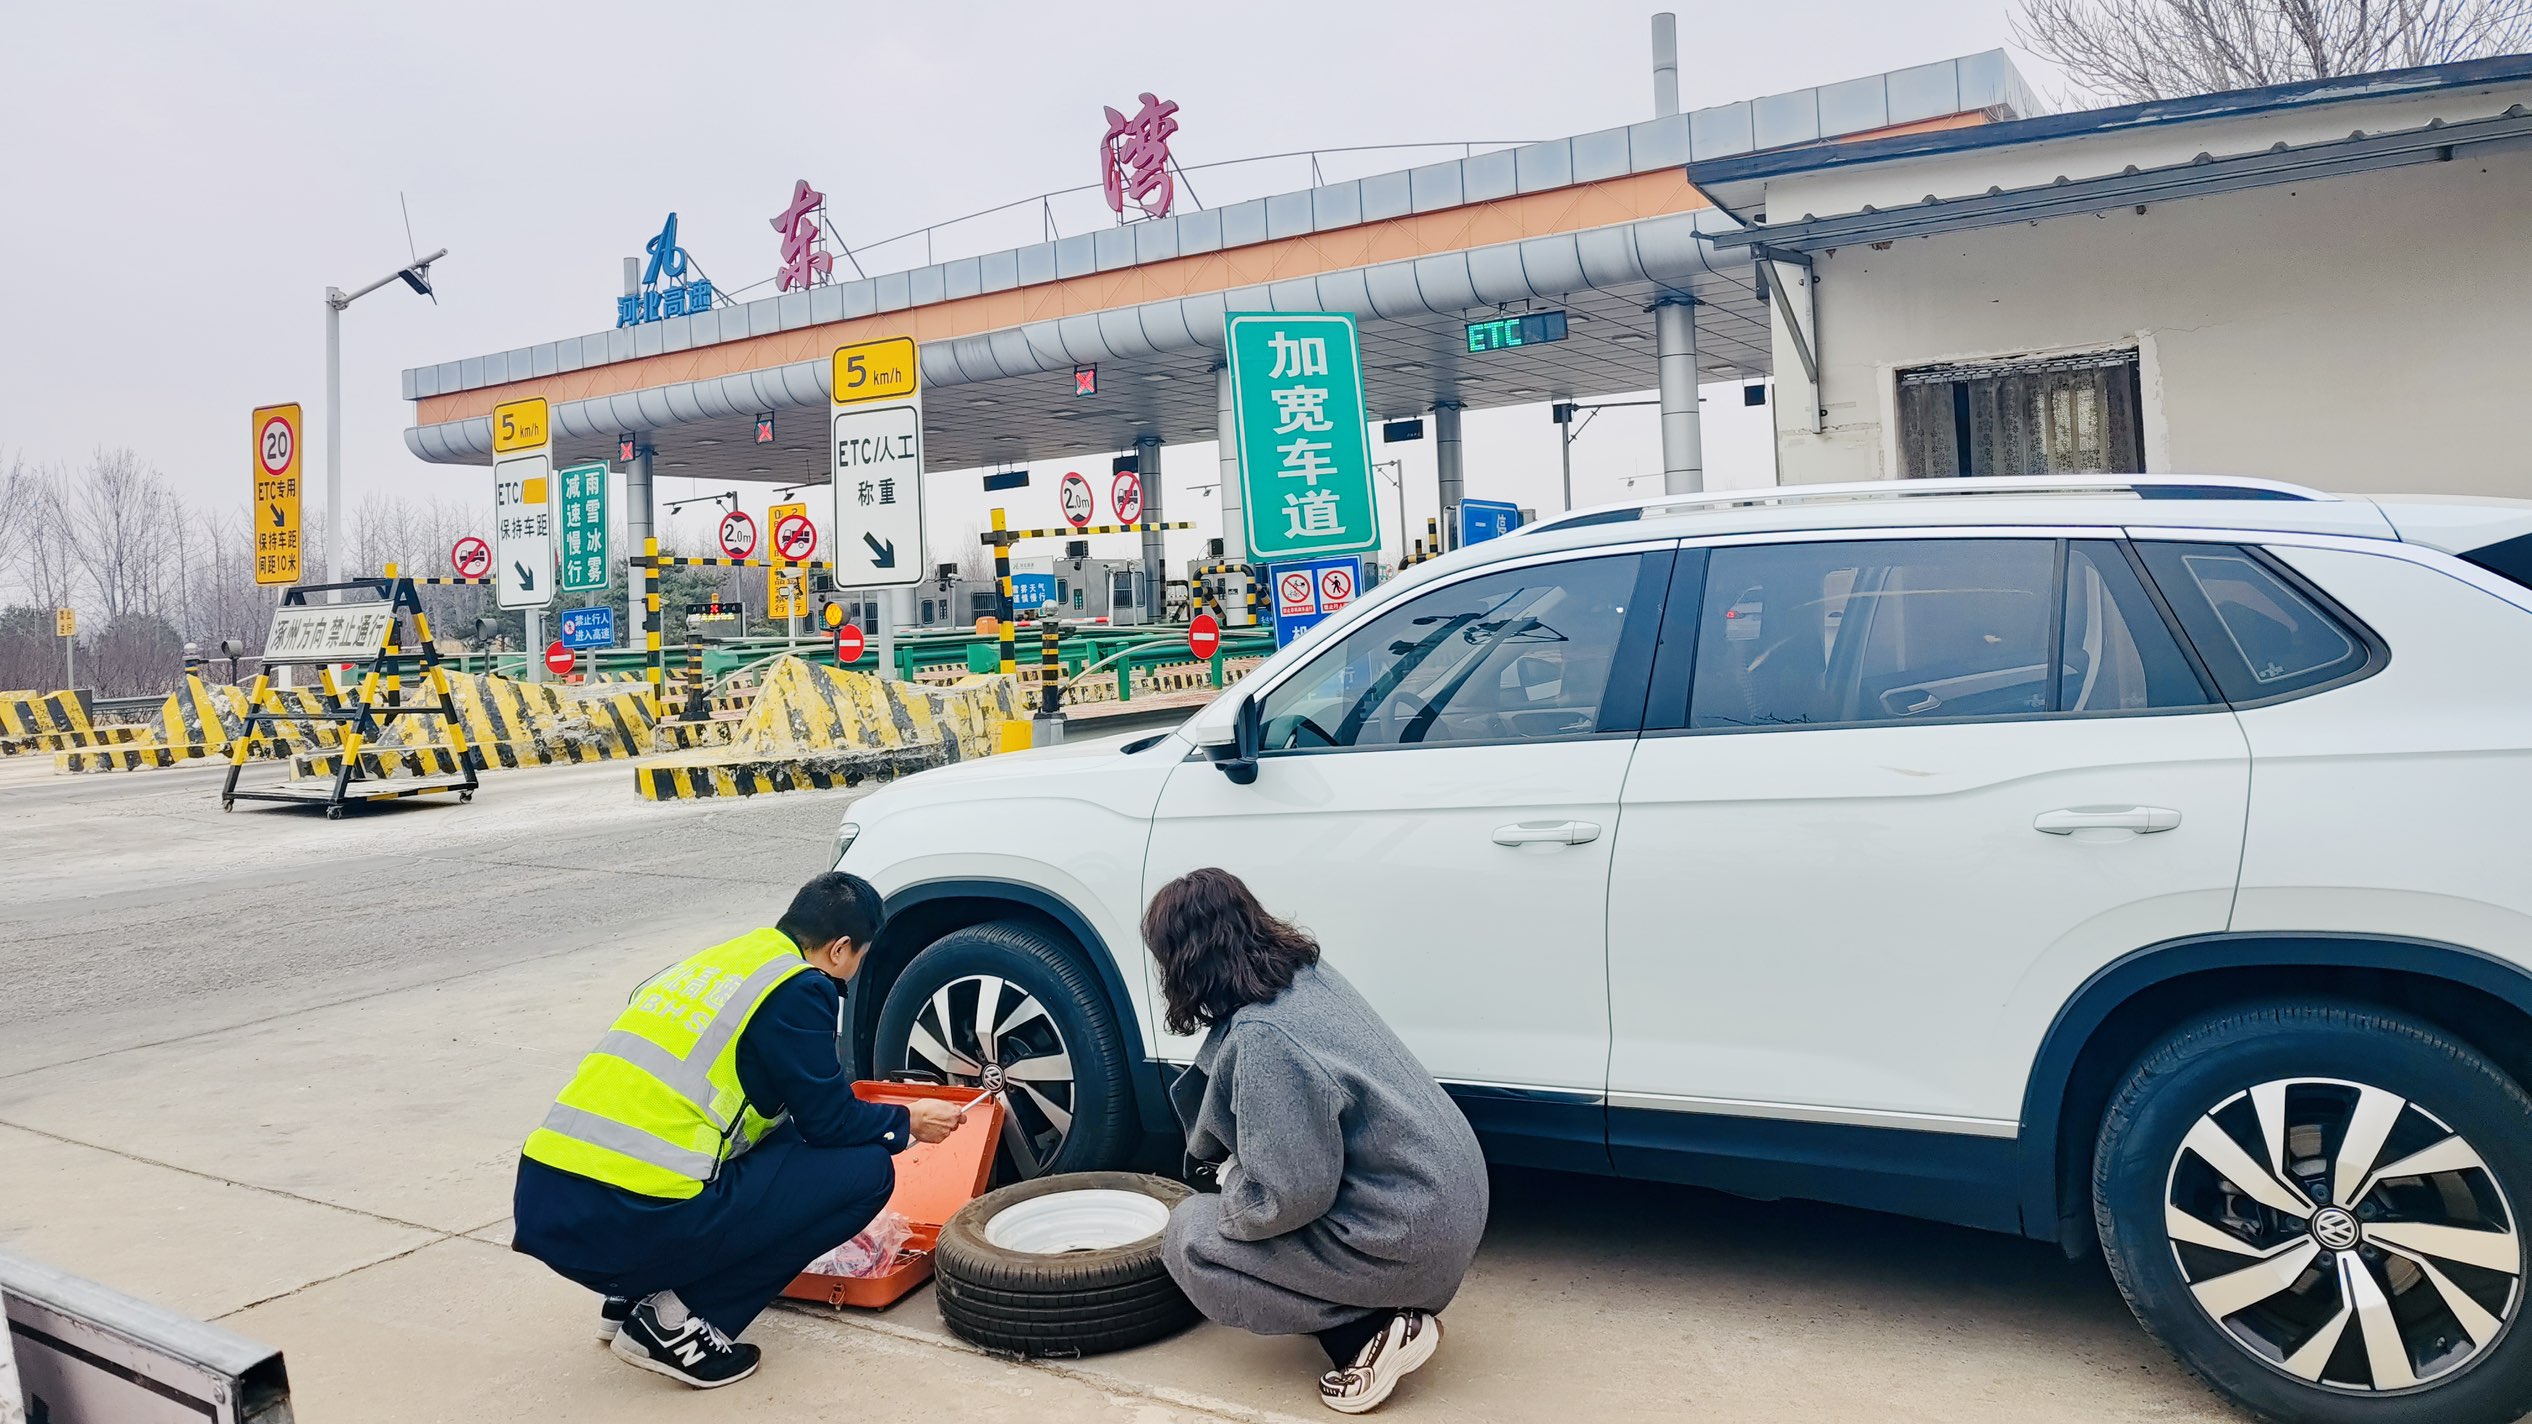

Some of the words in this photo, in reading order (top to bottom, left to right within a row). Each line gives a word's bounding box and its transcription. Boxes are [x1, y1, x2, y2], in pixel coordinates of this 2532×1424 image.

[616, 279, 712, 328] 河北高速
[1468, 318, 1522, 351] ETC
[847, 355, 867, 388] 5
[873, 368, 902, 386] km/h
[502, 413, 515, 441] 5
[519, 423, 540, 439] km/h
[1267, 331, 1347, 539] 加宽车道
[266, 431, 288, 460] 20
[838, 435, 915, 468] ETC/人工
[258, 478, 296, 501] ETC专用
[857, 477, 896, 507] 称重
[1063, 487, 1090, 509] 2.0m
[258, 529, 297, 551] 保持车距
[500, 513, 548, 541] 保持车距
[565, 474, 583, 584] 减速慢行
[585, 471, 603, 584] 雨雪冰雾
[724, 523, 752, 543] 2.0m
[258, 552, 297, 575] 间距10米
[575, 613, 609, 627] 禁止行人
[575, 627, 611, 642] 进入高速
[673, 1340, 707, 1368] N
